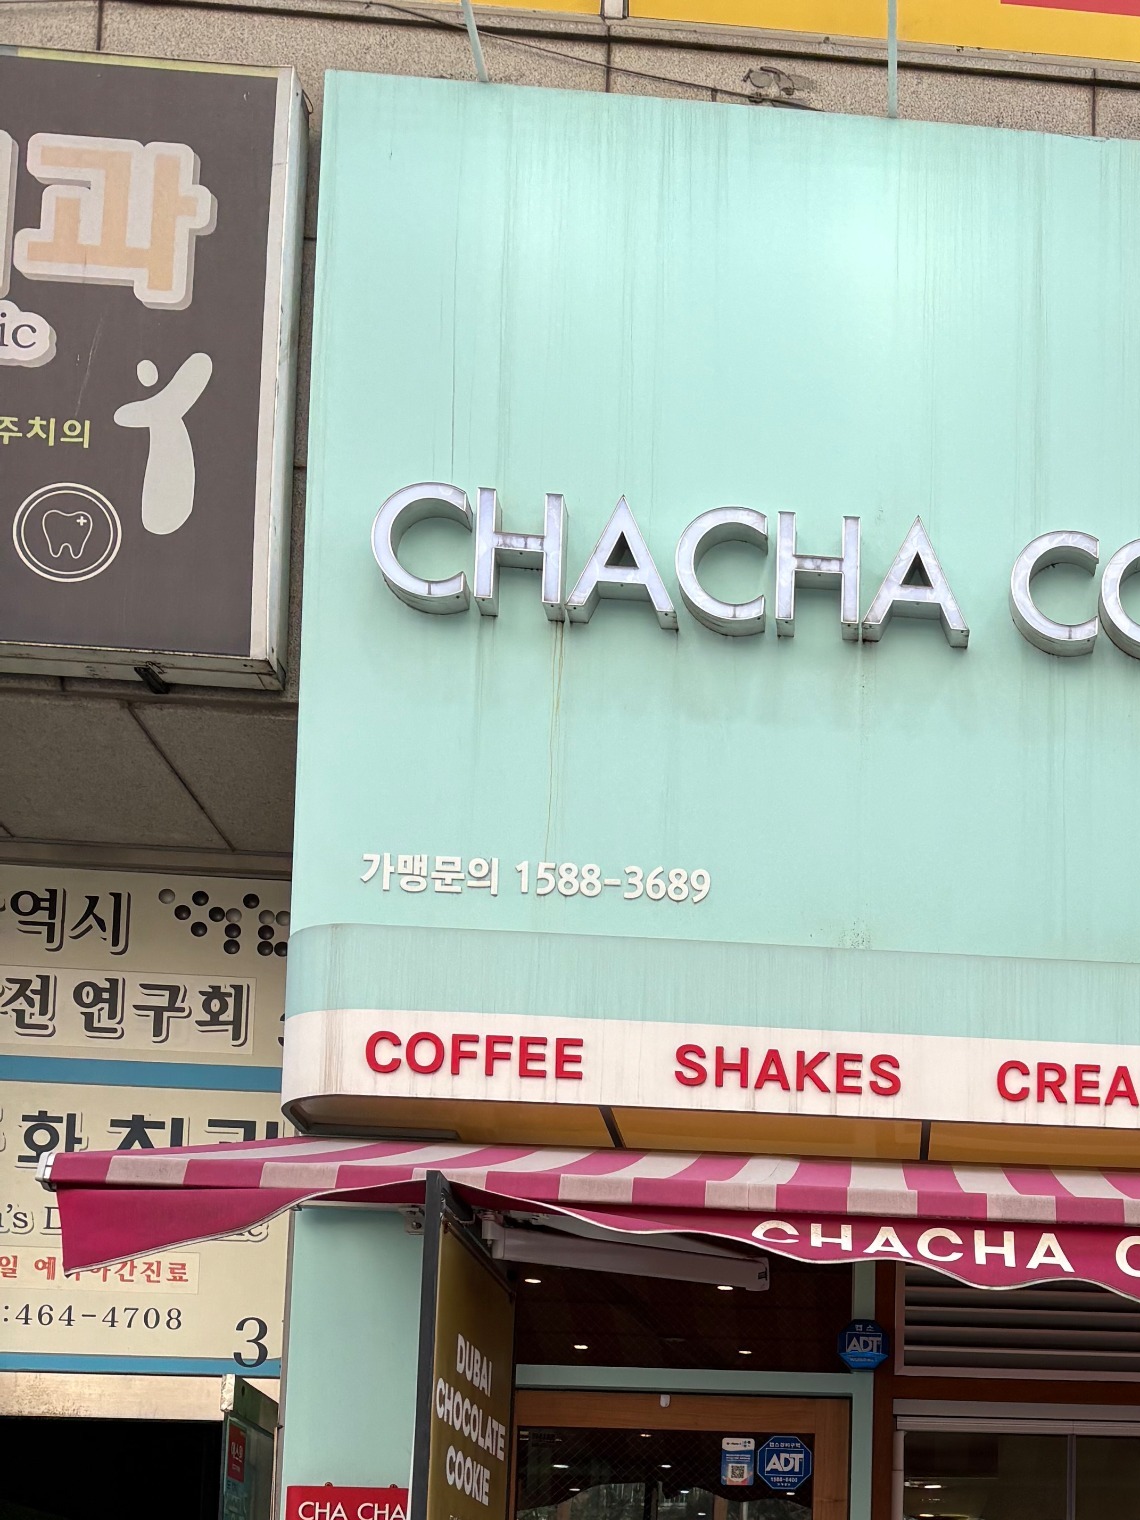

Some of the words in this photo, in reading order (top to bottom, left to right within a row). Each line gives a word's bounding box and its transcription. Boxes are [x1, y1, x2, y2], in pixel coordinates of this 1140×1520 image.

[371, 481, 970, 648] CHACHA
[360, 852, 499, 896] 가맹문의
[514, 860, 711, 903] 1588-3689
[73, 975, 251, 1047] 연구회
[365, 1030, 584, 1080] COFFEE
[674, 1043, 902, 1097] SHAKES
[751, 1219, 1074, 1273] CHACHA
[233, 1316, 269, 1368] 3
[456, 1333, 493, 1398] DUBAI
[847, 1336, 881, 1353] ADT
[435, 1376, 506, 1462] CHOCOLATE
[445, 1444, 491, 1507] COOKIE
[765, 1453, 804, 1472] ADT
